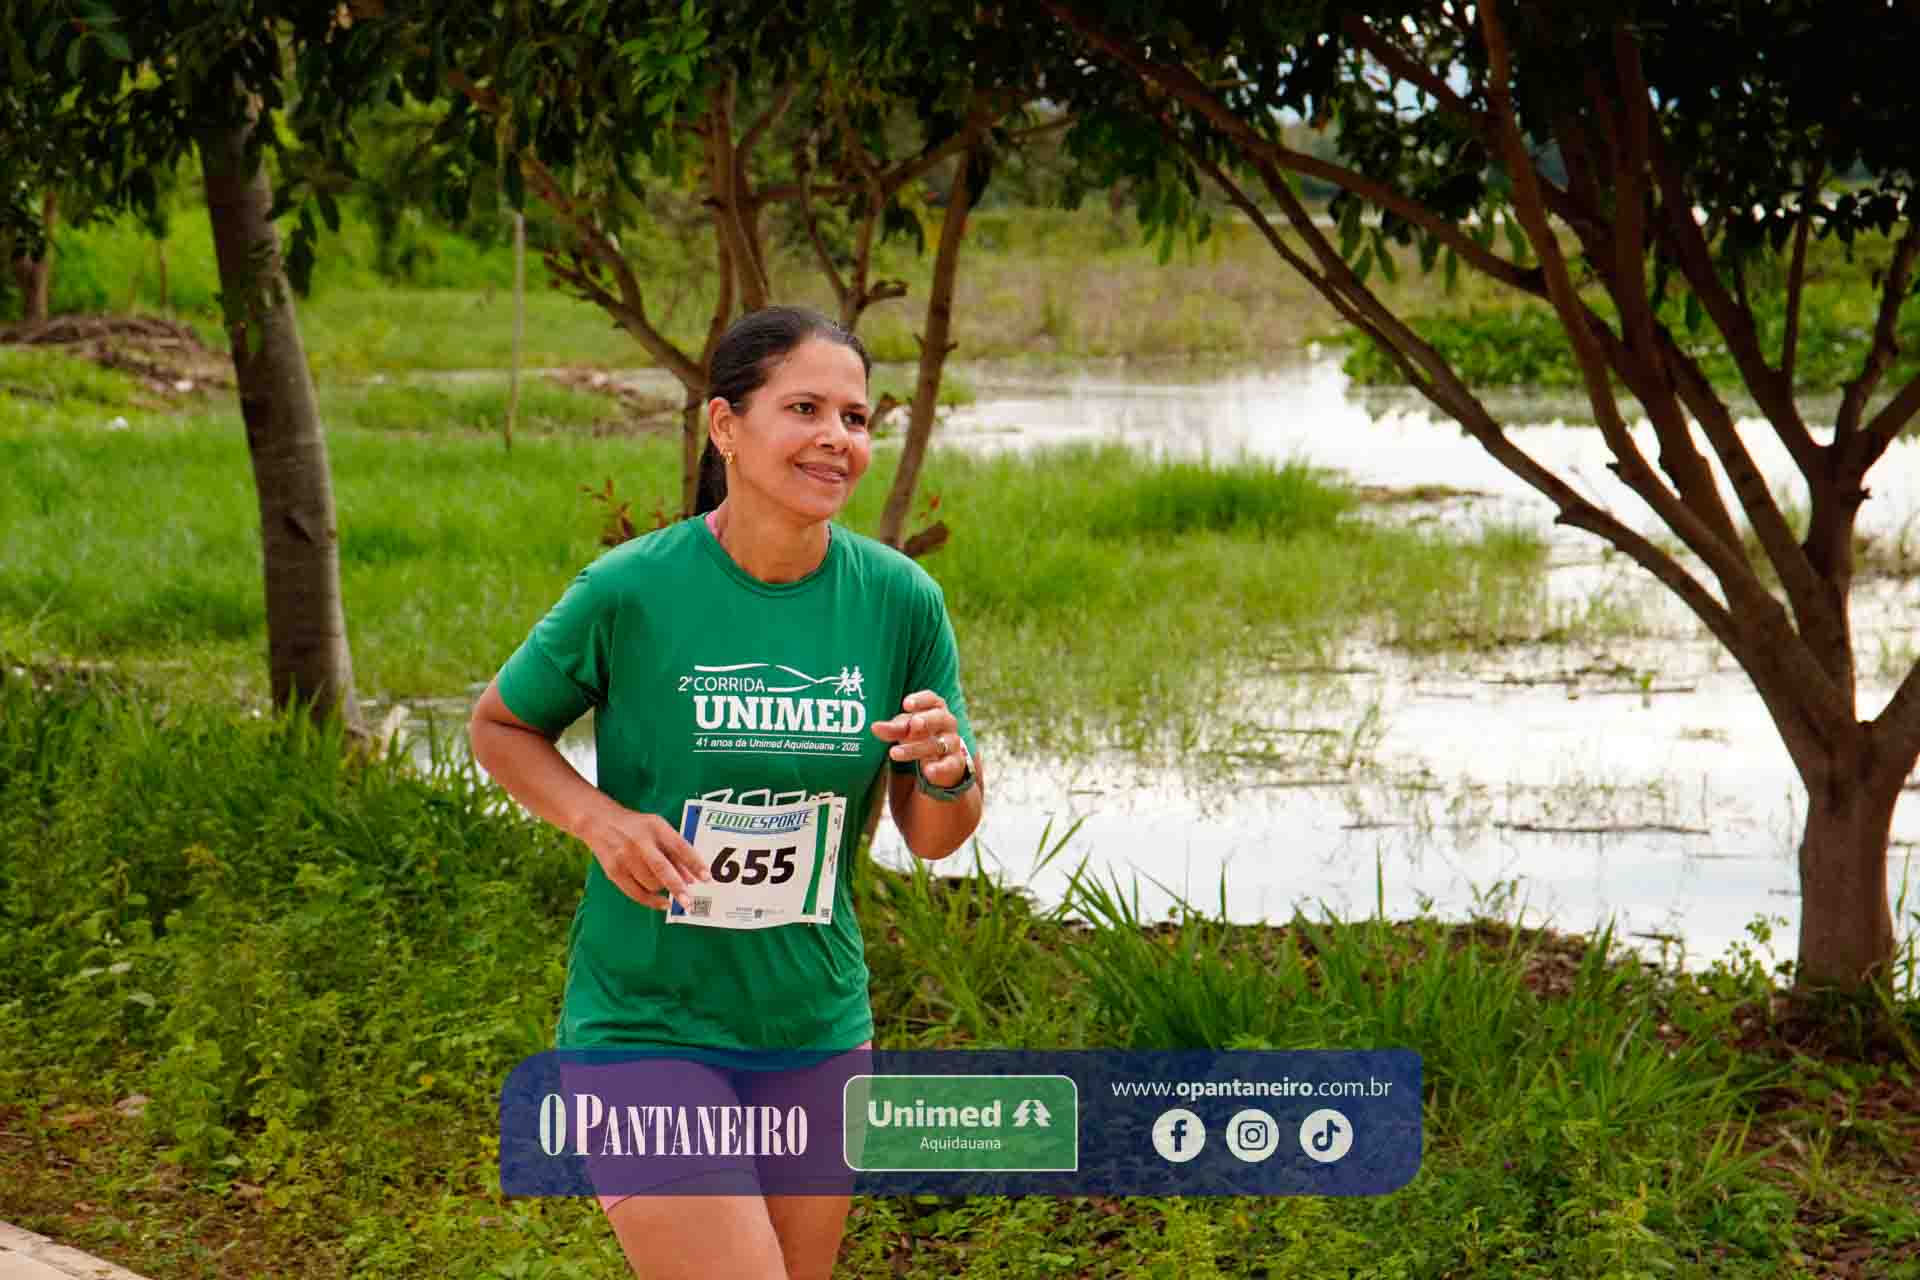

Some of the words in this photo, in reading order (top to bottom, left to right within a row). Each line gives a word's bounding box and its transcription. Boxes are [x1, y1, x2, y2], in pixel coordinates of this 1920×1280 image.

[694, 677, 766, 693] CORRIDA
[693, 695, 866, 734] UNIMED
[696, 737, 707, 748] 41
[710, 739, 733, 748] anos
[749, 738, 782, 749] Unimed
[783, 740, 835, 752] Aquidauana
[710, 846, 797, 886] 655
